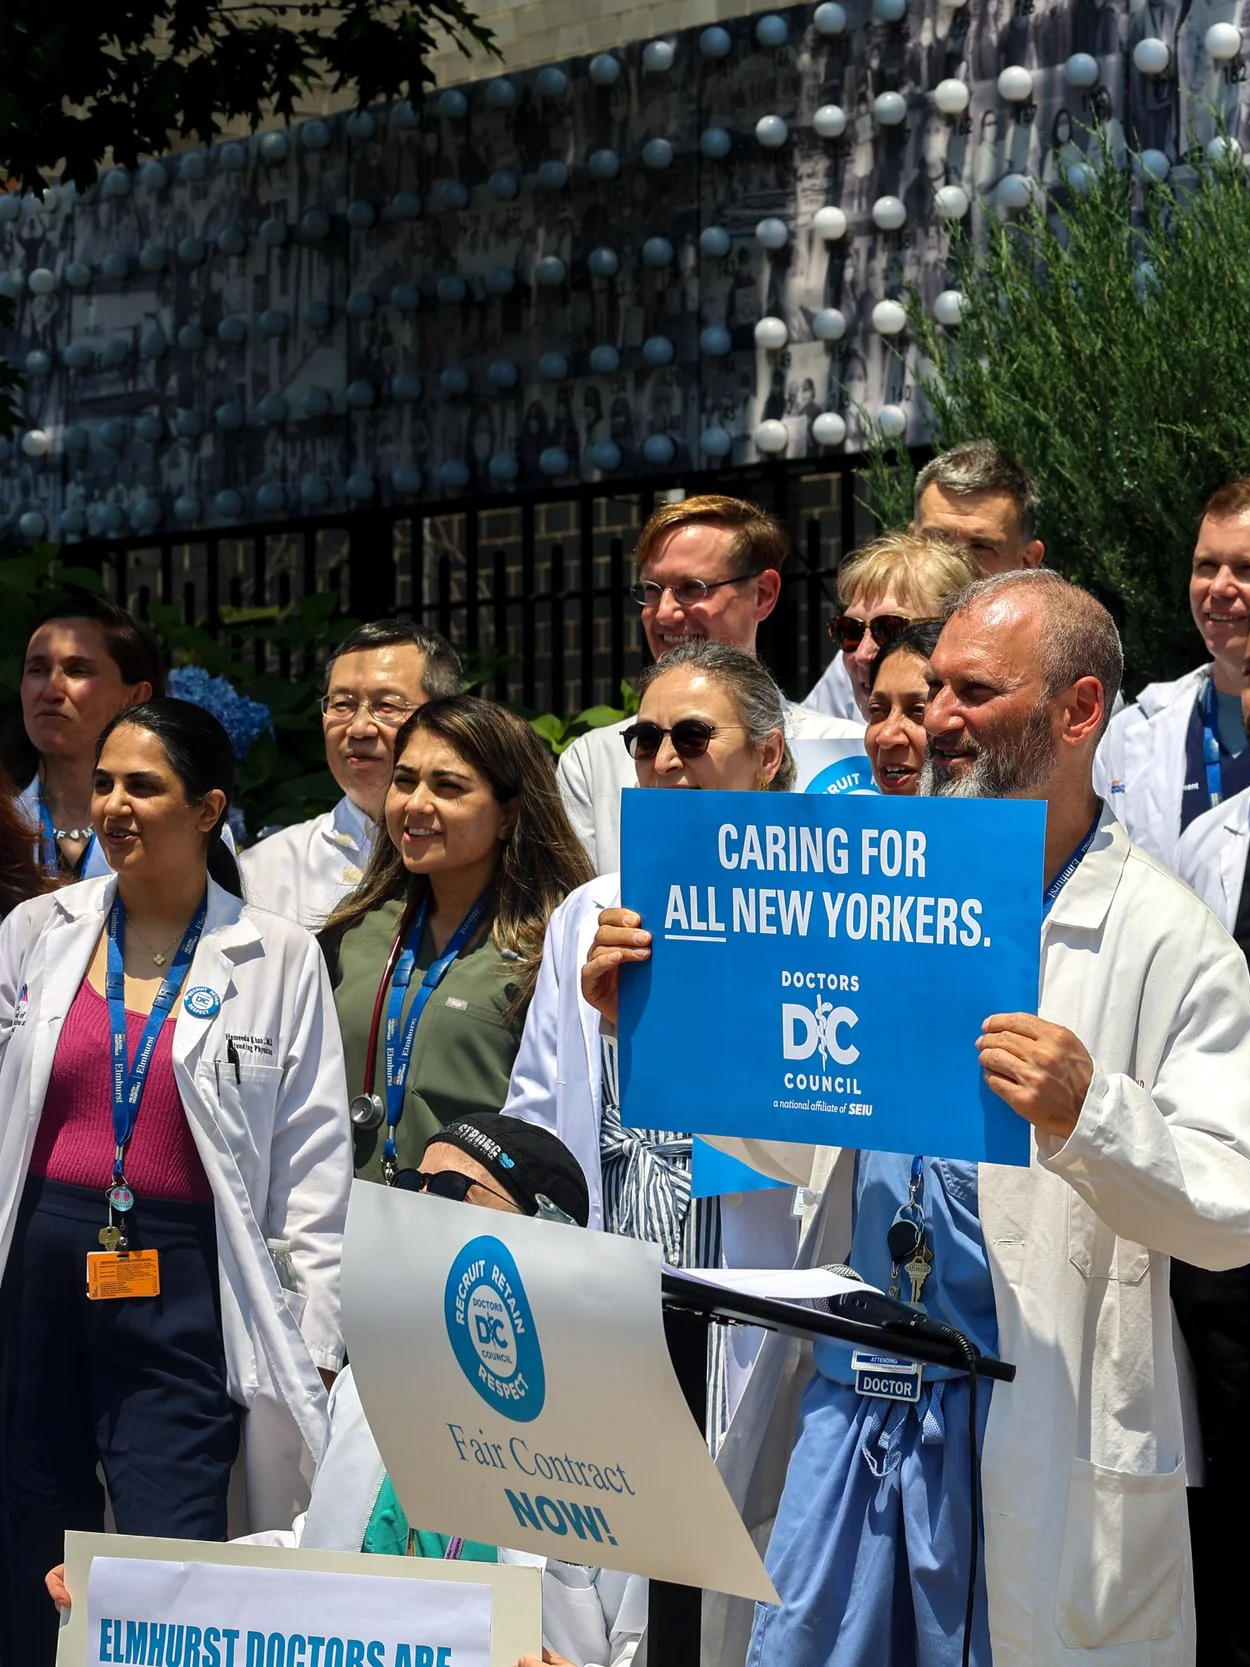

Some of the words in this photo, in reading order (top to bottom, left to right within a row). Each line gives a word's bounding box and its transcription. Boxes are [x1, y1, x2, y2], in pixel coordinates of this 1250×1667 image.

[1221, 65, 1247, 85] 182
[822, 773, 860, 794] RUIT
[718, 823, 849, 874] CARING
[861, 829, 927, 878] FOR
[664, 885, 726, 932] ALL
[733, 887, 814, 938] NEW
[822, 892, 991, 948] YORKERS.
[781, 971, 860, 992] DOCTORS
[136, 1036, 155, 1074] Elmhurst
[115, 1063, 123, 1103] Elmhurst
[784, 1073, 862, 1095] COUNCIL
[779, 1099, 809, 1110] national
[810, 1101, 839, 1113] affiliate
[839, 1104, 847, 1114] of
[848, 1103, 874, 1116] SEIU
[456, 1123, 502, 1161] STRONG
[456, 1259, 486, 1325] RECRUIT
[491, 1264, 526, 1334] RETAIN
[472, 1297, 503, 1313] DOCTORS
[481, 1349, 513, 1365] COUNCIL
[478, 1364, 529, 1400] RESPECT
[863, 1376, 912, 1396] DOCTOR
[445, 1422, 508, 1470] Fair
[508, 1437, 636, 1496] Contract
[504, 1487, 619, 1546] NOW!
[99, 1617, 241, 1667] ELMHURST
[246, 1630, 392, 1667] DOCTORS
